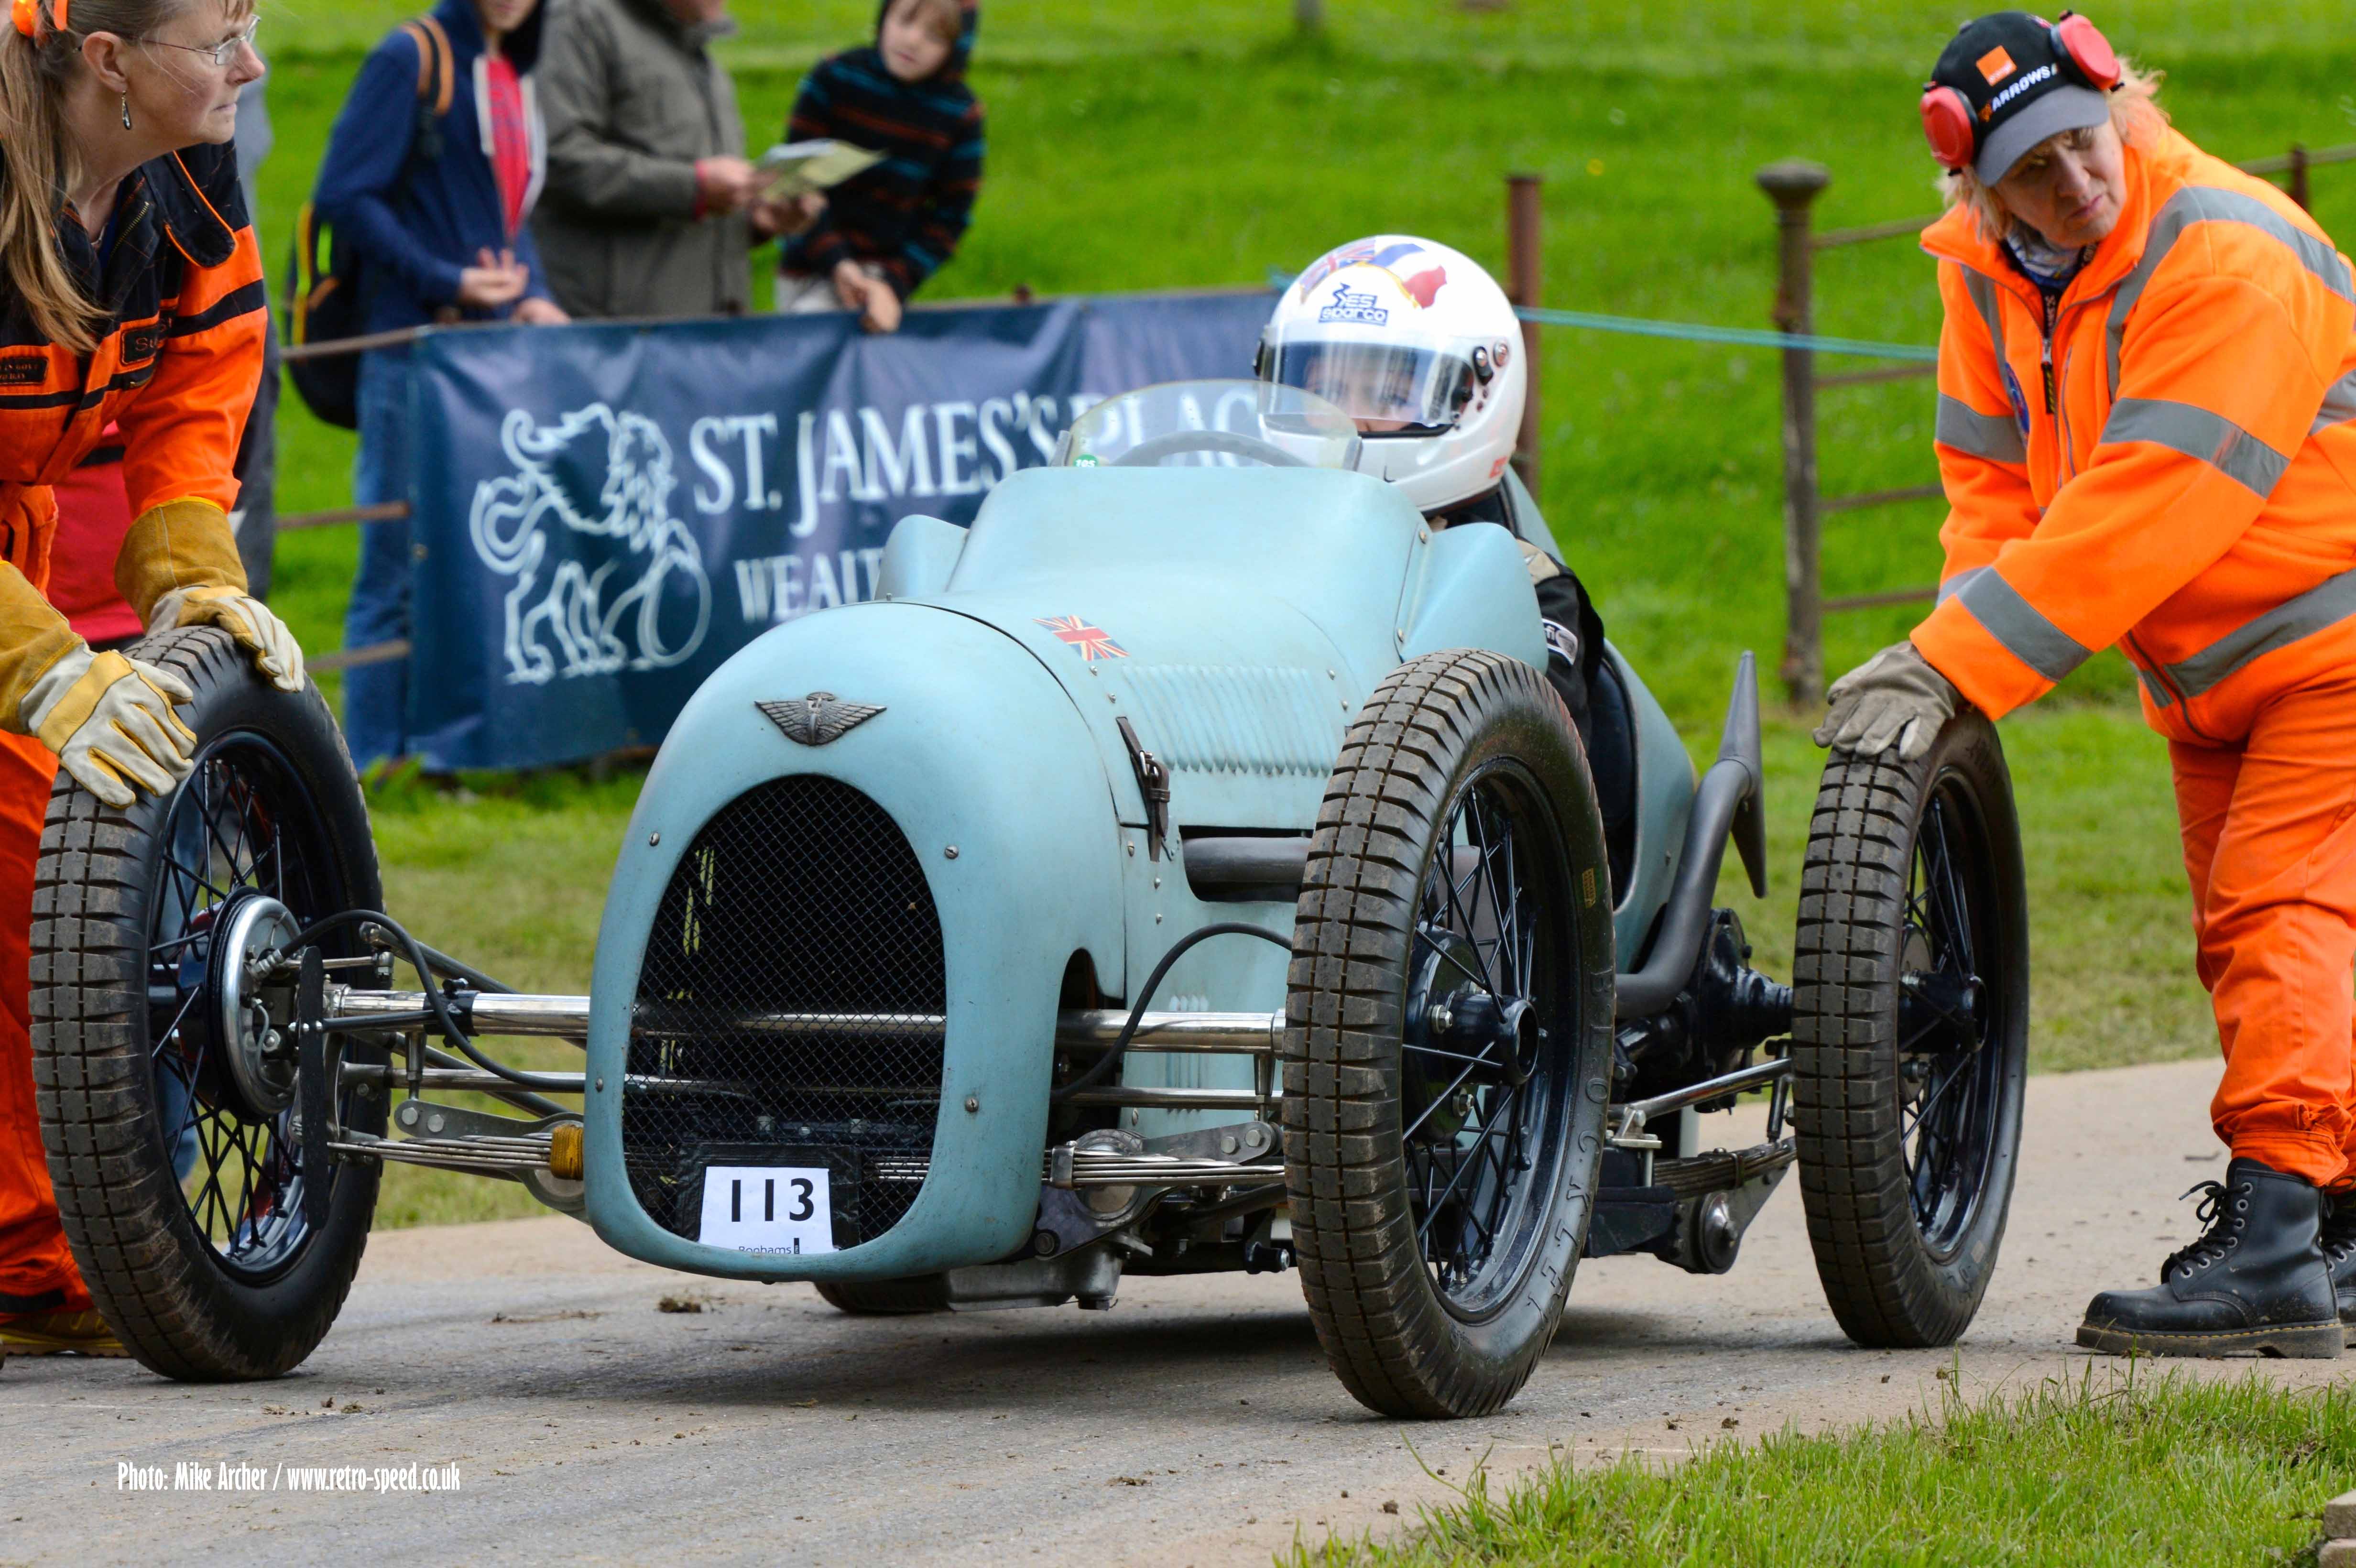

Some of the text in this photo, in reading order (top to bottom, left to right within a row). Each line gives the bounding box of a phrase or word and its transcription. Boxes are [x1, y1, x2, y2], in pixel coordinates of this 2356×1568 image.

[1992, 65, 2051, 112] ARROWS
[689, 413, 783, 514] ST.
[734, 547, 883, 622] WEALT
[731, 1178, 814, 1222] 113
